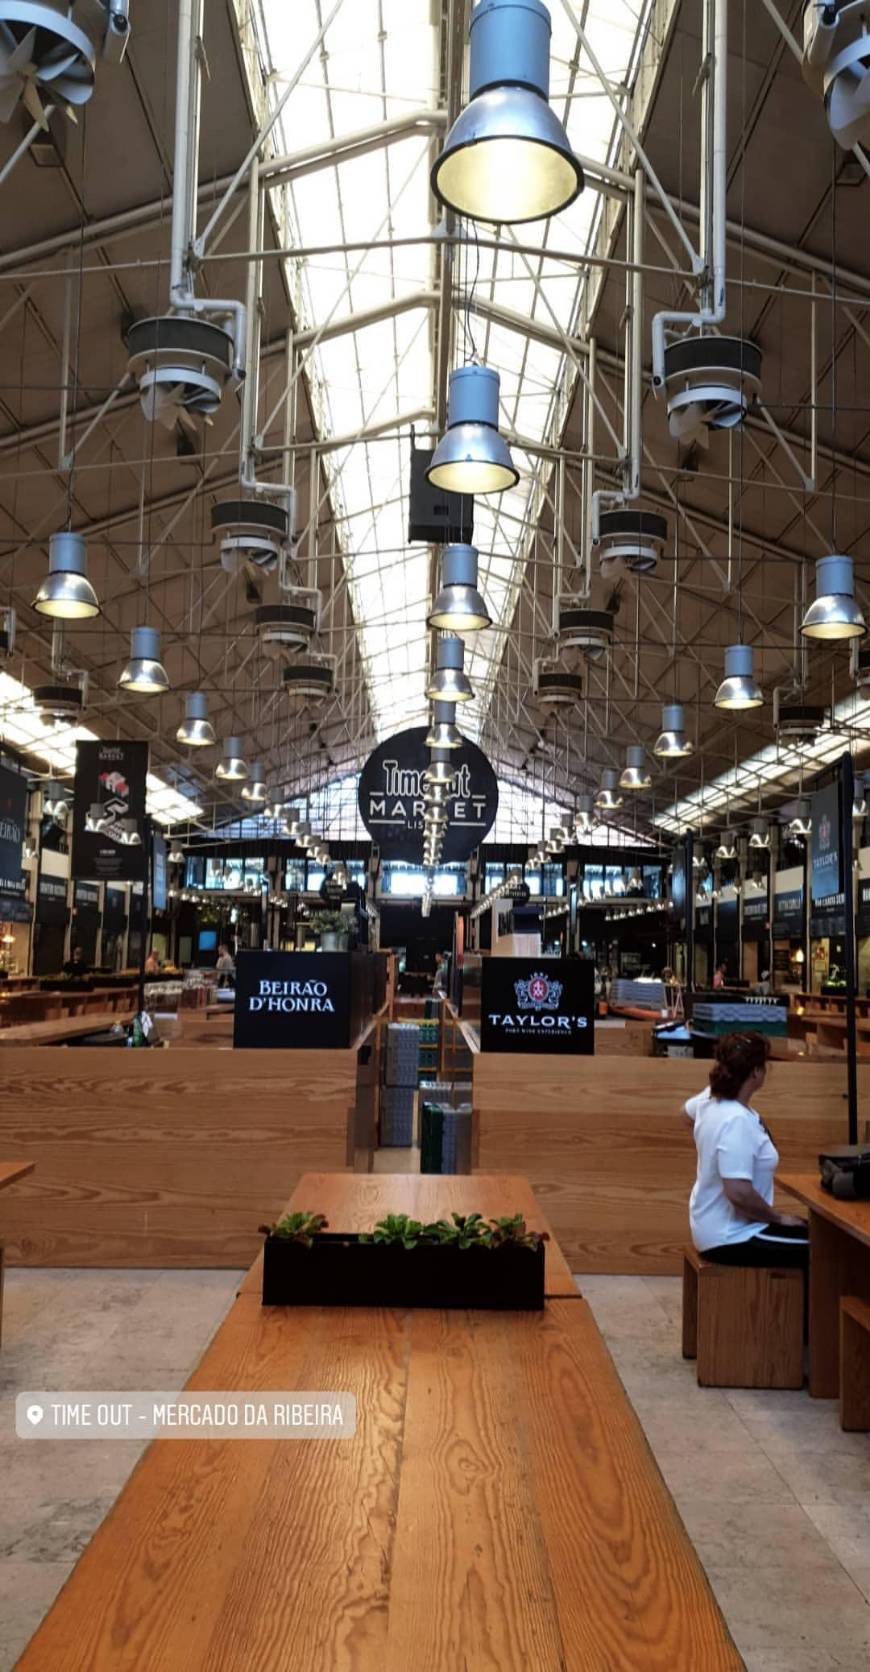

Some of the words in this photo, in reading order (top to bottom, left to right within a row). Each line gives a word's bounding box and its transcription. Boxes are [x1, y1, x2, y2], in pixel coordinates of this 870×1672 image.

[369, 800, 486, 819] MARET
[407, 822, 448, 830] LISA
[259, 979, 327, 997] BEIRÃO
[248, 996, 336, 1013] D'HONRA
[488, 1014, 588, 1029] TAYLOR'S
